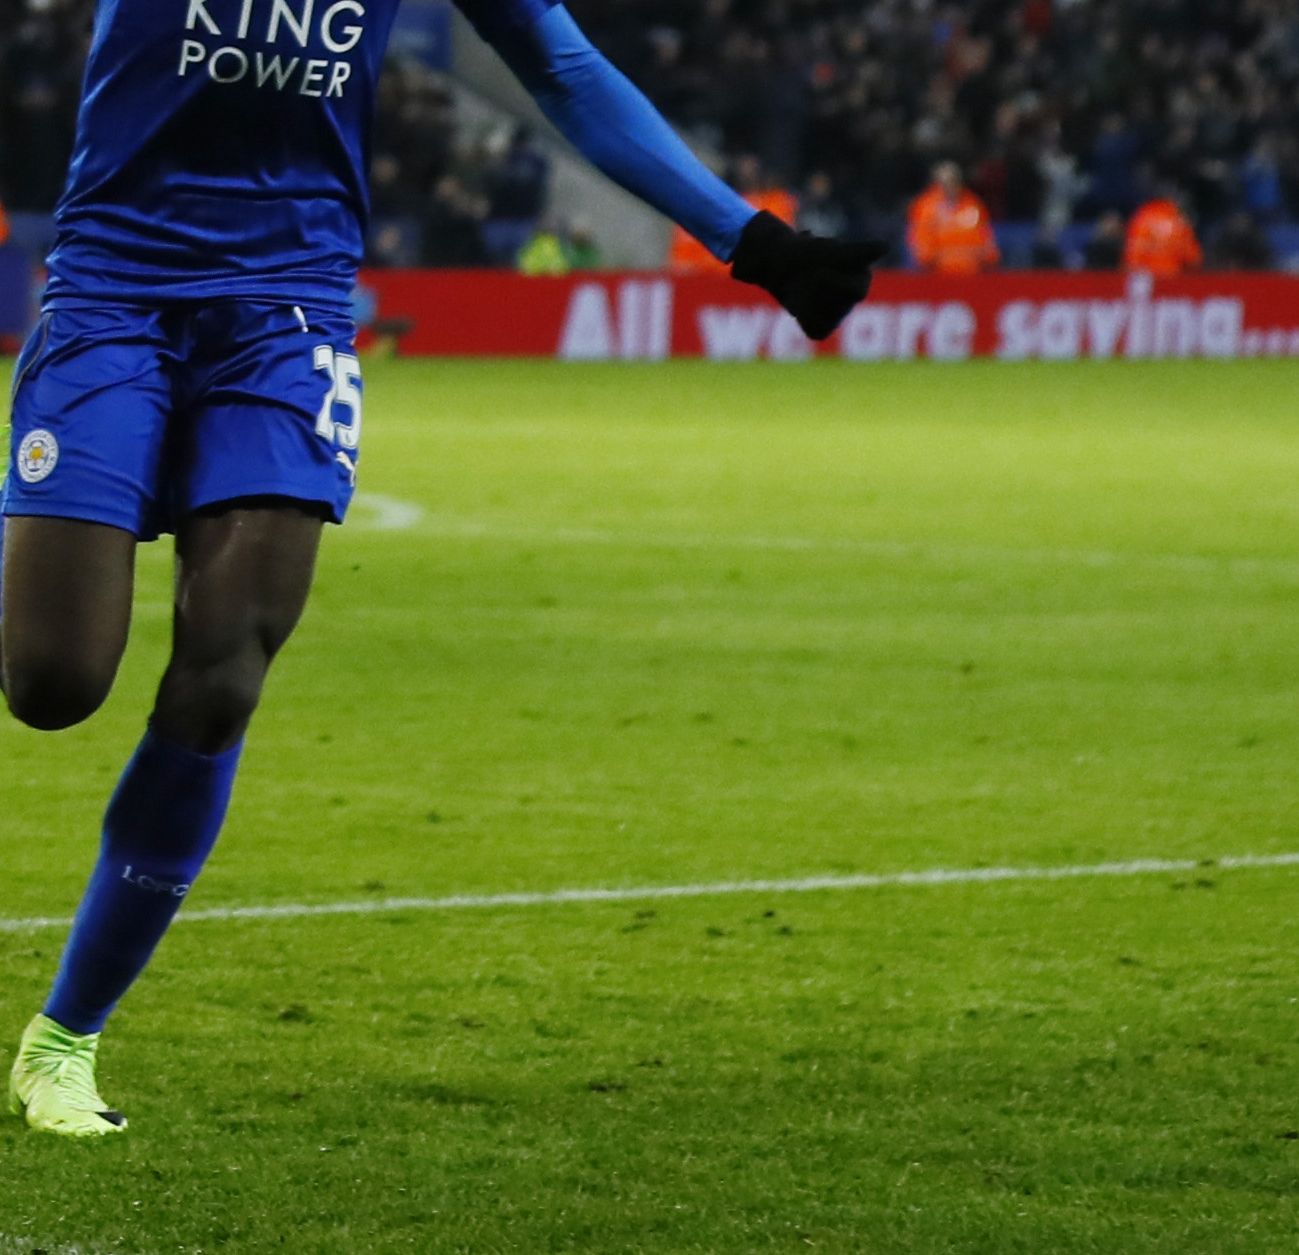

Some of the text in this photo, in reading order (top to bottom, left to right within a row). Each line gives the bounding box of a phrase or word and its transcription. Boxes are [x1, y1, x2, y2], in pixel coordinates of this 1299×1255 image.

[177, 39, 352, 98] POWER
[557, 280, 673, 361] All
[841, 304, 978, 361] are
[313, 344, 363, 450] 25
